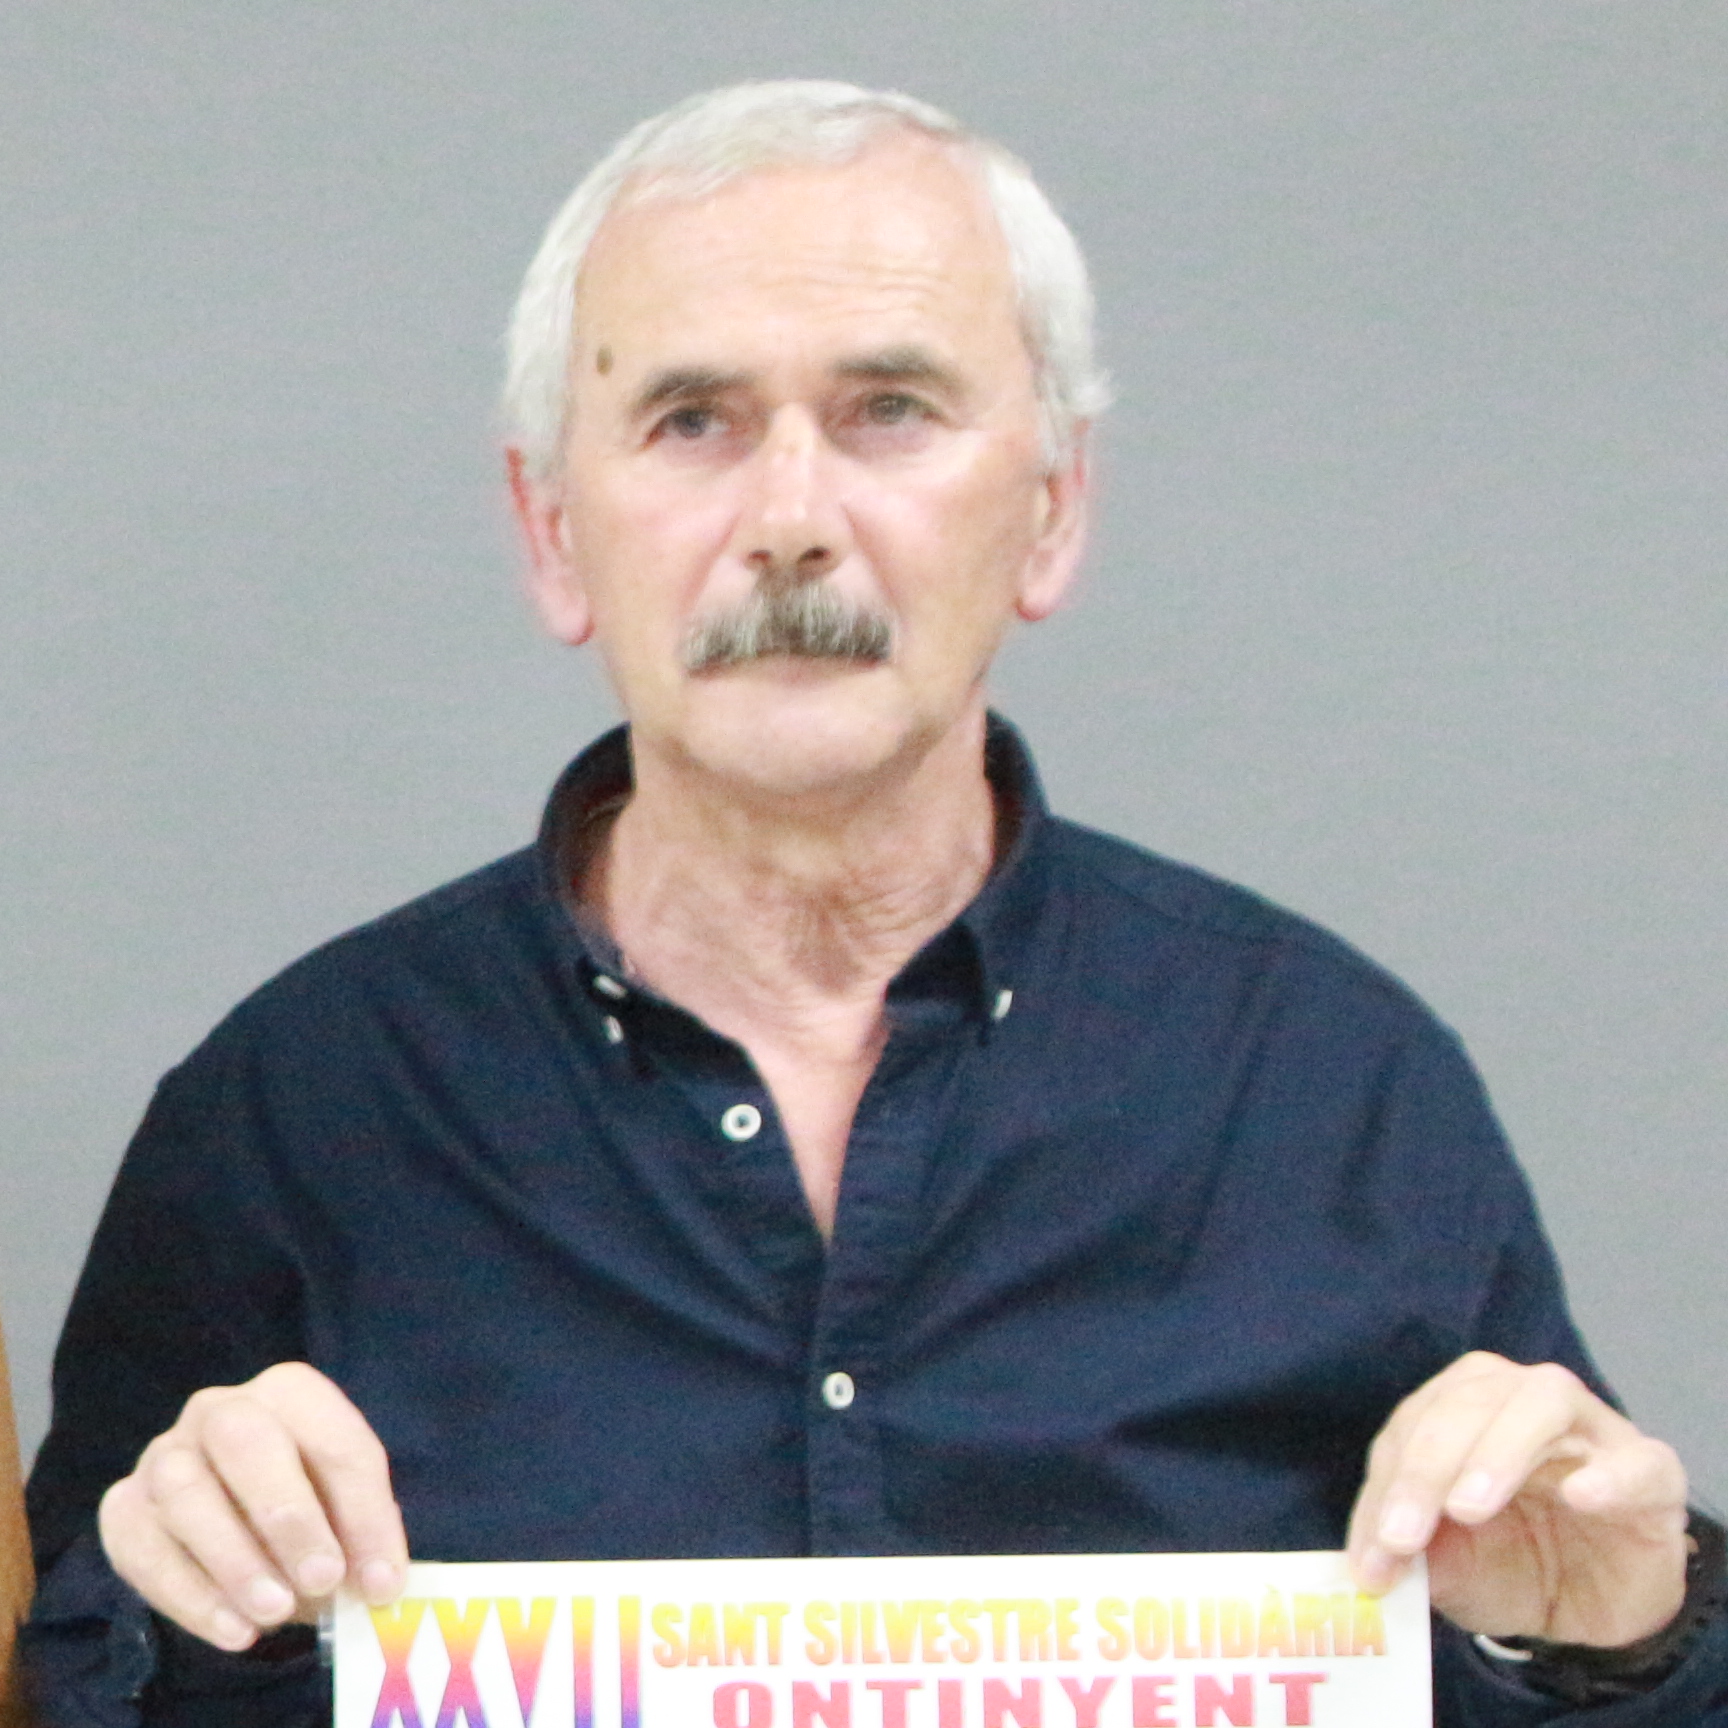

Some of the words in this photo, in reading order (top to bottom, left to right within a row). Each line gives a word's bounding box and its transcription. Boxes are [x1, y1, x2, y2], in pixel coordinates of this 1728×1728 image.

[650, 1602, 790, 1668] SANT
[803, 1598, 1080, 1666] SILVESTRE
[1096, 1584, 1386, 1660] SOLIDÀRIA
